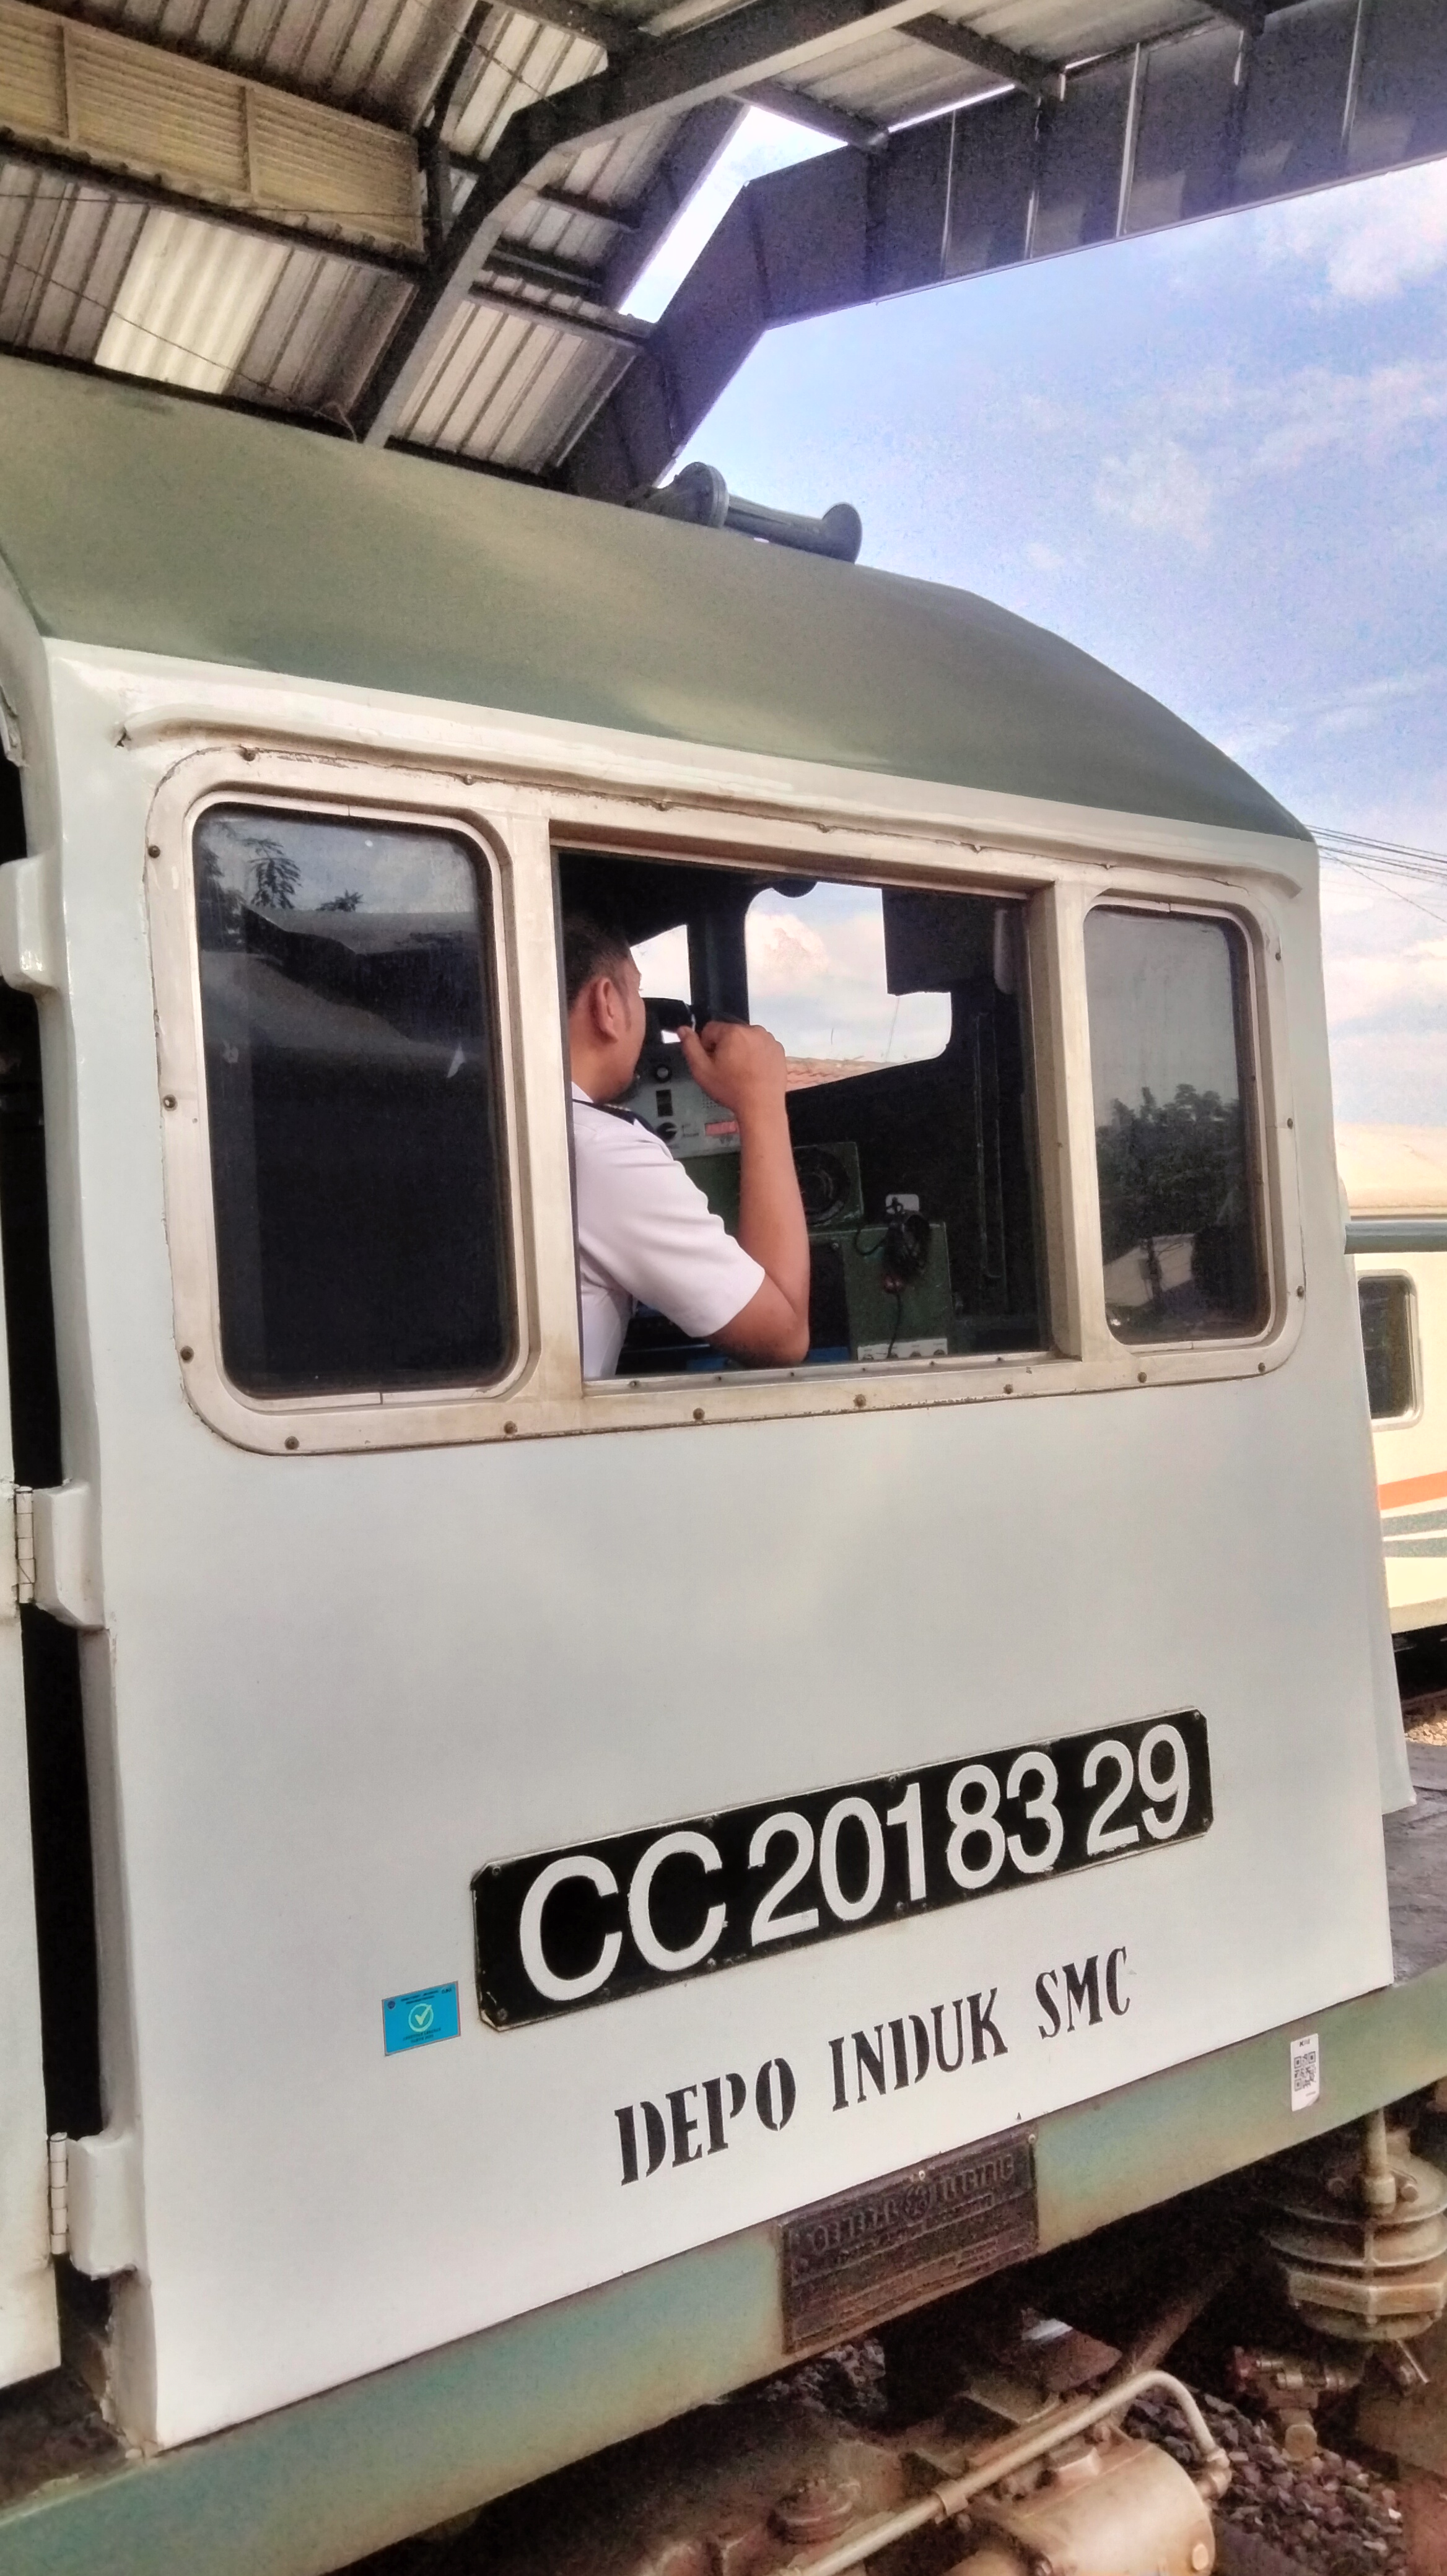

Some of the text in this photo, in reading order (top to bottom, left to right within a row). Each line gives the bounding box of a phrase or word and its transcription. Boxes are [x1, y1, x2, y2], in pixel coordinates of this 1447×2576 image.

[520, 1831, 728, 2001] CC
[1083, 1725, 1191, 1856] 29
[614, 1946, 1130, 2186] DEPO INDUK SMC
